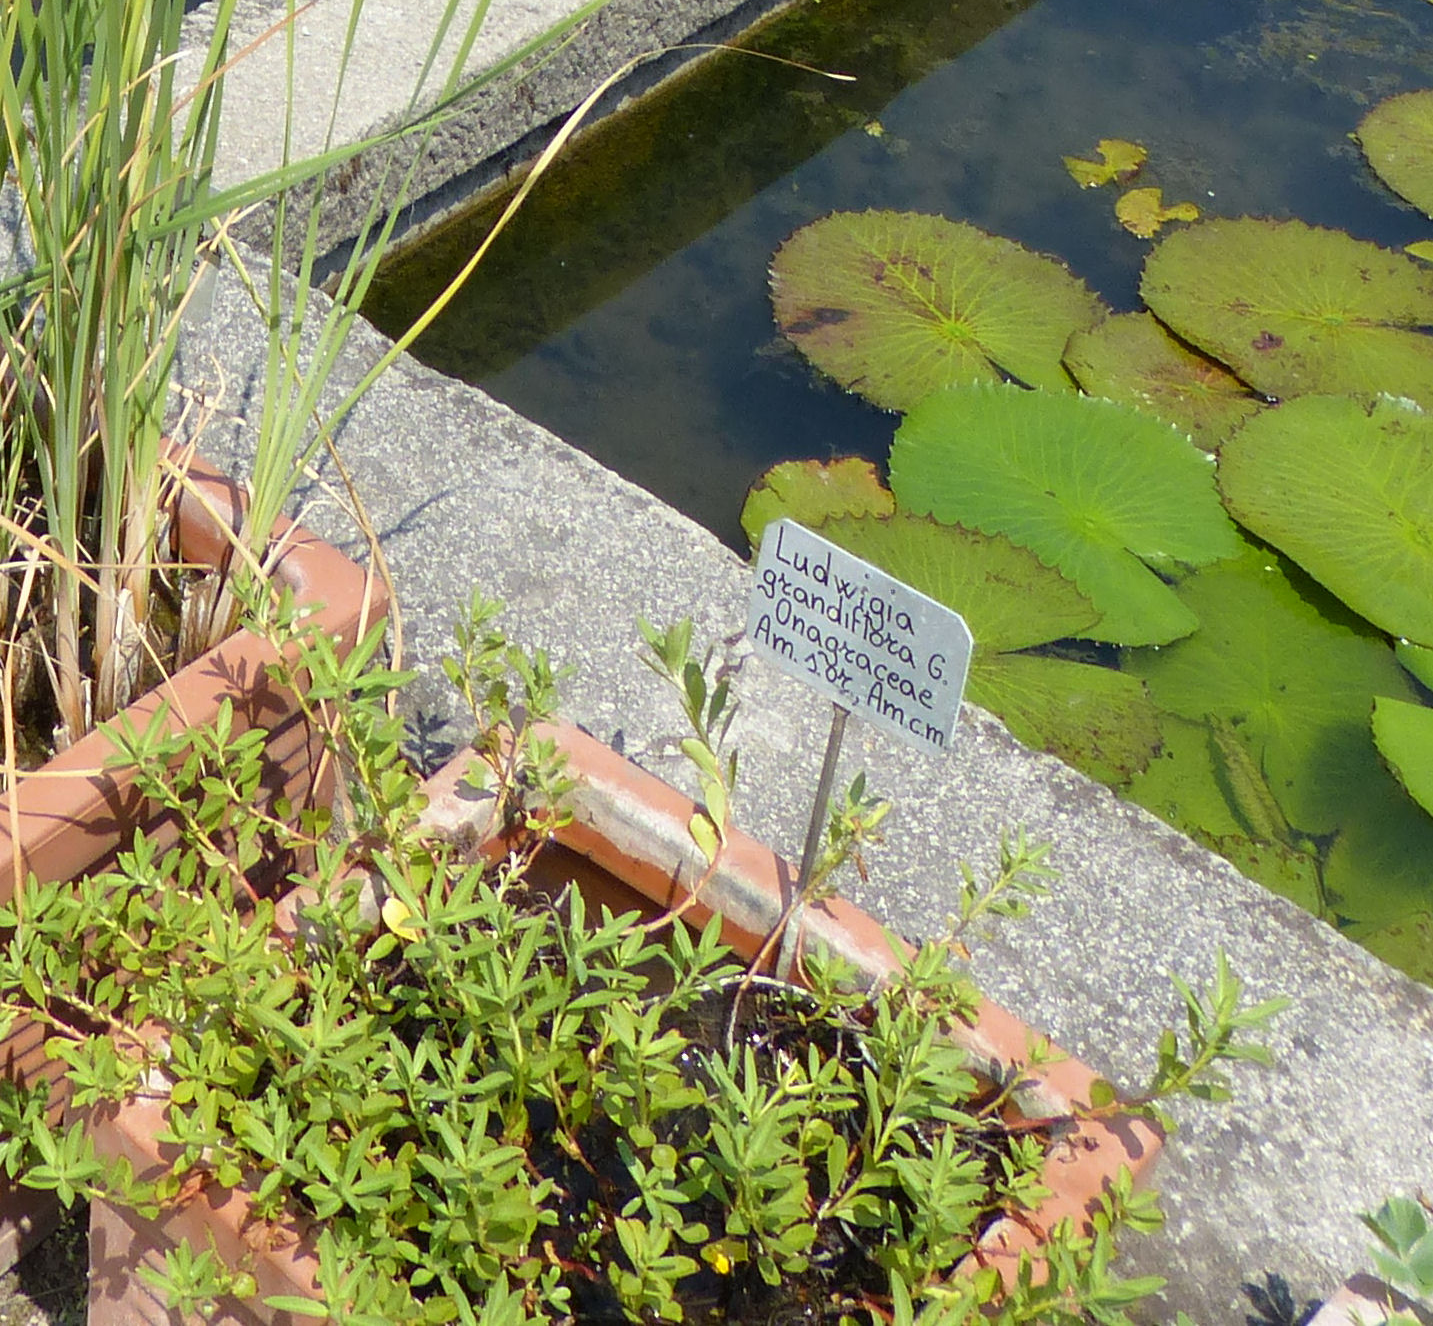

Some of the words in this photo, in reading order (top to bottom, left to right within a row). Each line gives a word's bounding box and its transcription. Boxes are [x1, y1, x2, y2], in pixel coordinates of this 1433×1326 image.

[756, 568, 916, 669] grandiflora
[927, 653, 948, 686] G.
[775, 525, 915, 636] Ludwigia
[775, 597, 934, 710] Onagraceae
